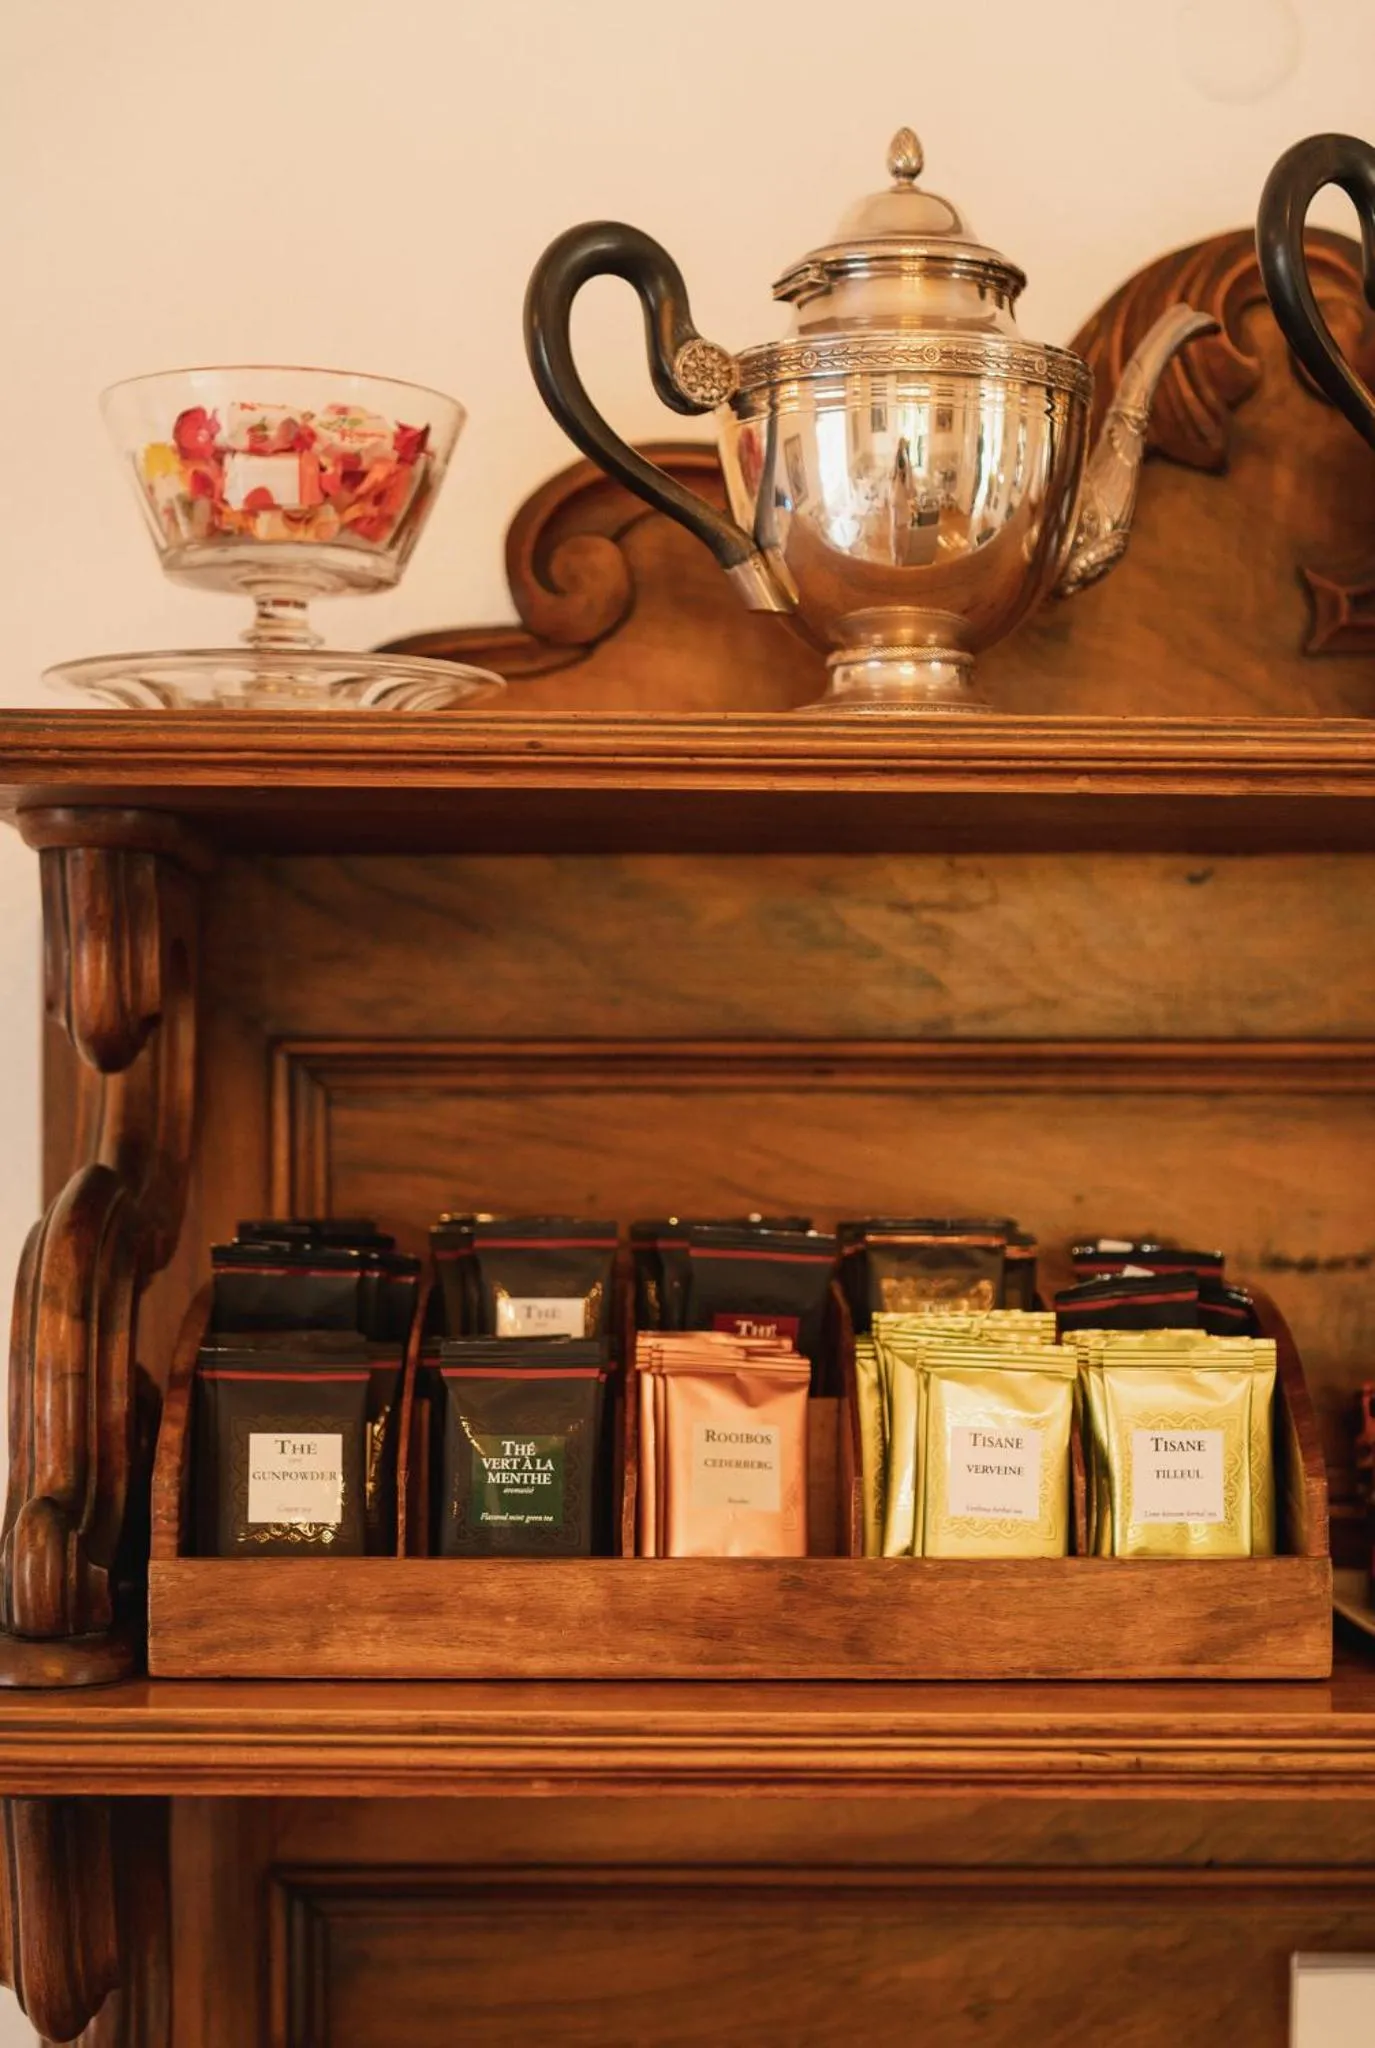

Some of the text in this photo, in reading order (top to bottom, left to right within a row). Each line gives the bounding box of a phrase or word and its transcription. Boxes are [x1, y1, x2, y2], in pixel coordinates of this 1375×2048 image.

[704, 1428, 772, 1445] ROOIBOS
[968, 1432, 1024, 1449] TISANE
[501, 1440, 536, 1456] THÉ
[1150, 1437, 1207, 1452] TISANE
[482, 1457, 520, 1470] VERT
[535, 1458, 555, 1471] LA
[966, 1464, 1024, 1476] VERVEINE
[252, 1471, 337, 1481] GUNPOWDER
[487, 1472, 552, 1485] MENTHE
